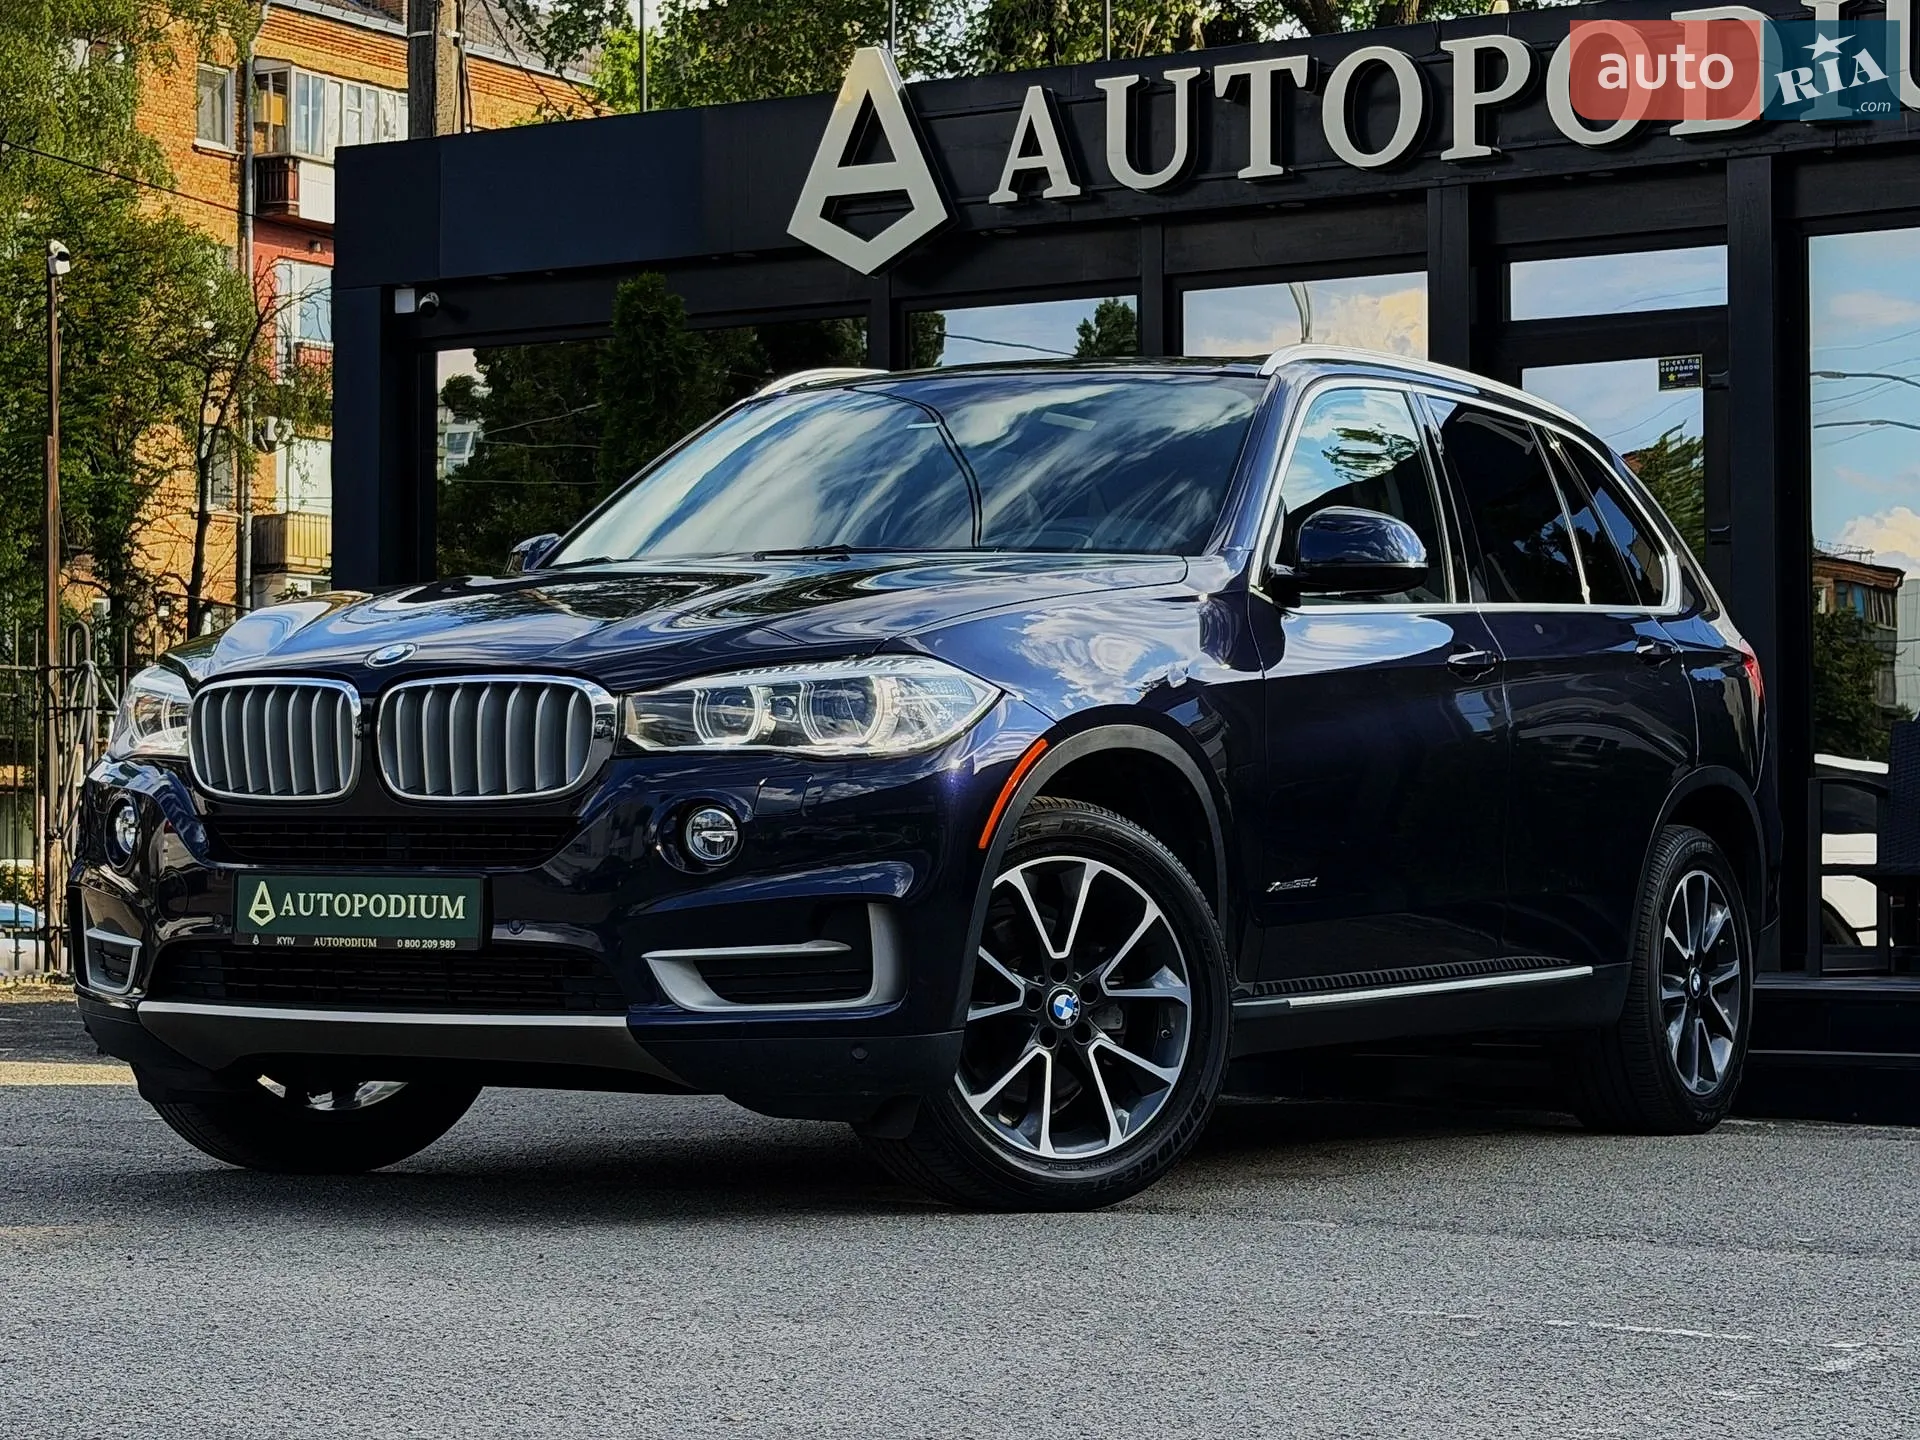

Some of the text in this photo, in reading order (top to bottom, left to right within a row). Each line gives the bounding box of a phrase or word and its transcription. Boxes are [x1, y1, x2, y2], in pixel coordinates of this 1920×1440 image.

[280, 892, 467, 919] AUTOPODIUM
[276, 935, 296, 946] KYIV
[313, 936, 378, 949] AUTOPODIUM
[397, 939, 456, 949] 0 800 209 989
